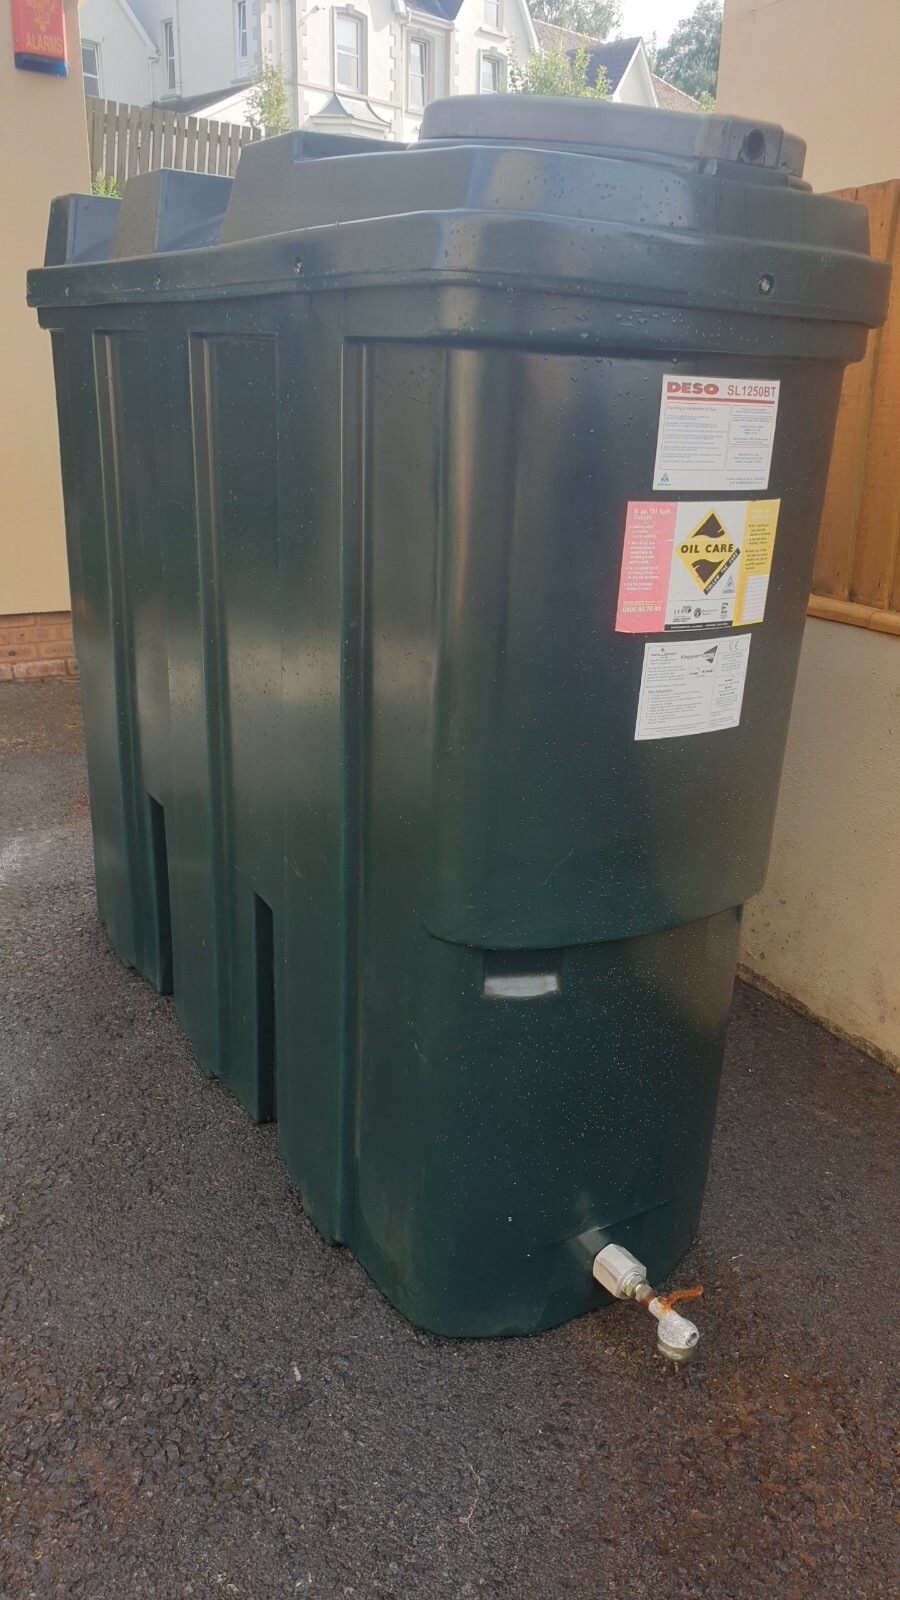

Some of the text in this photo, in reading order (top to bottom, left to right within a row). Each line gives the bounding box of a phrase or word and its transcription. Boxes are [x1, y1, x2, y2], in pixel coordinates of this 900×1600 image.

[26, 32, 63, 54] ALARMS
[667, 381, 777, 397] DESO SL1250BT
[659, 508, 671, 517] Spill
[680, 543, 734, 554] OIL CARE
[705, 552, 739, 592] FOLLOW THE CODE
